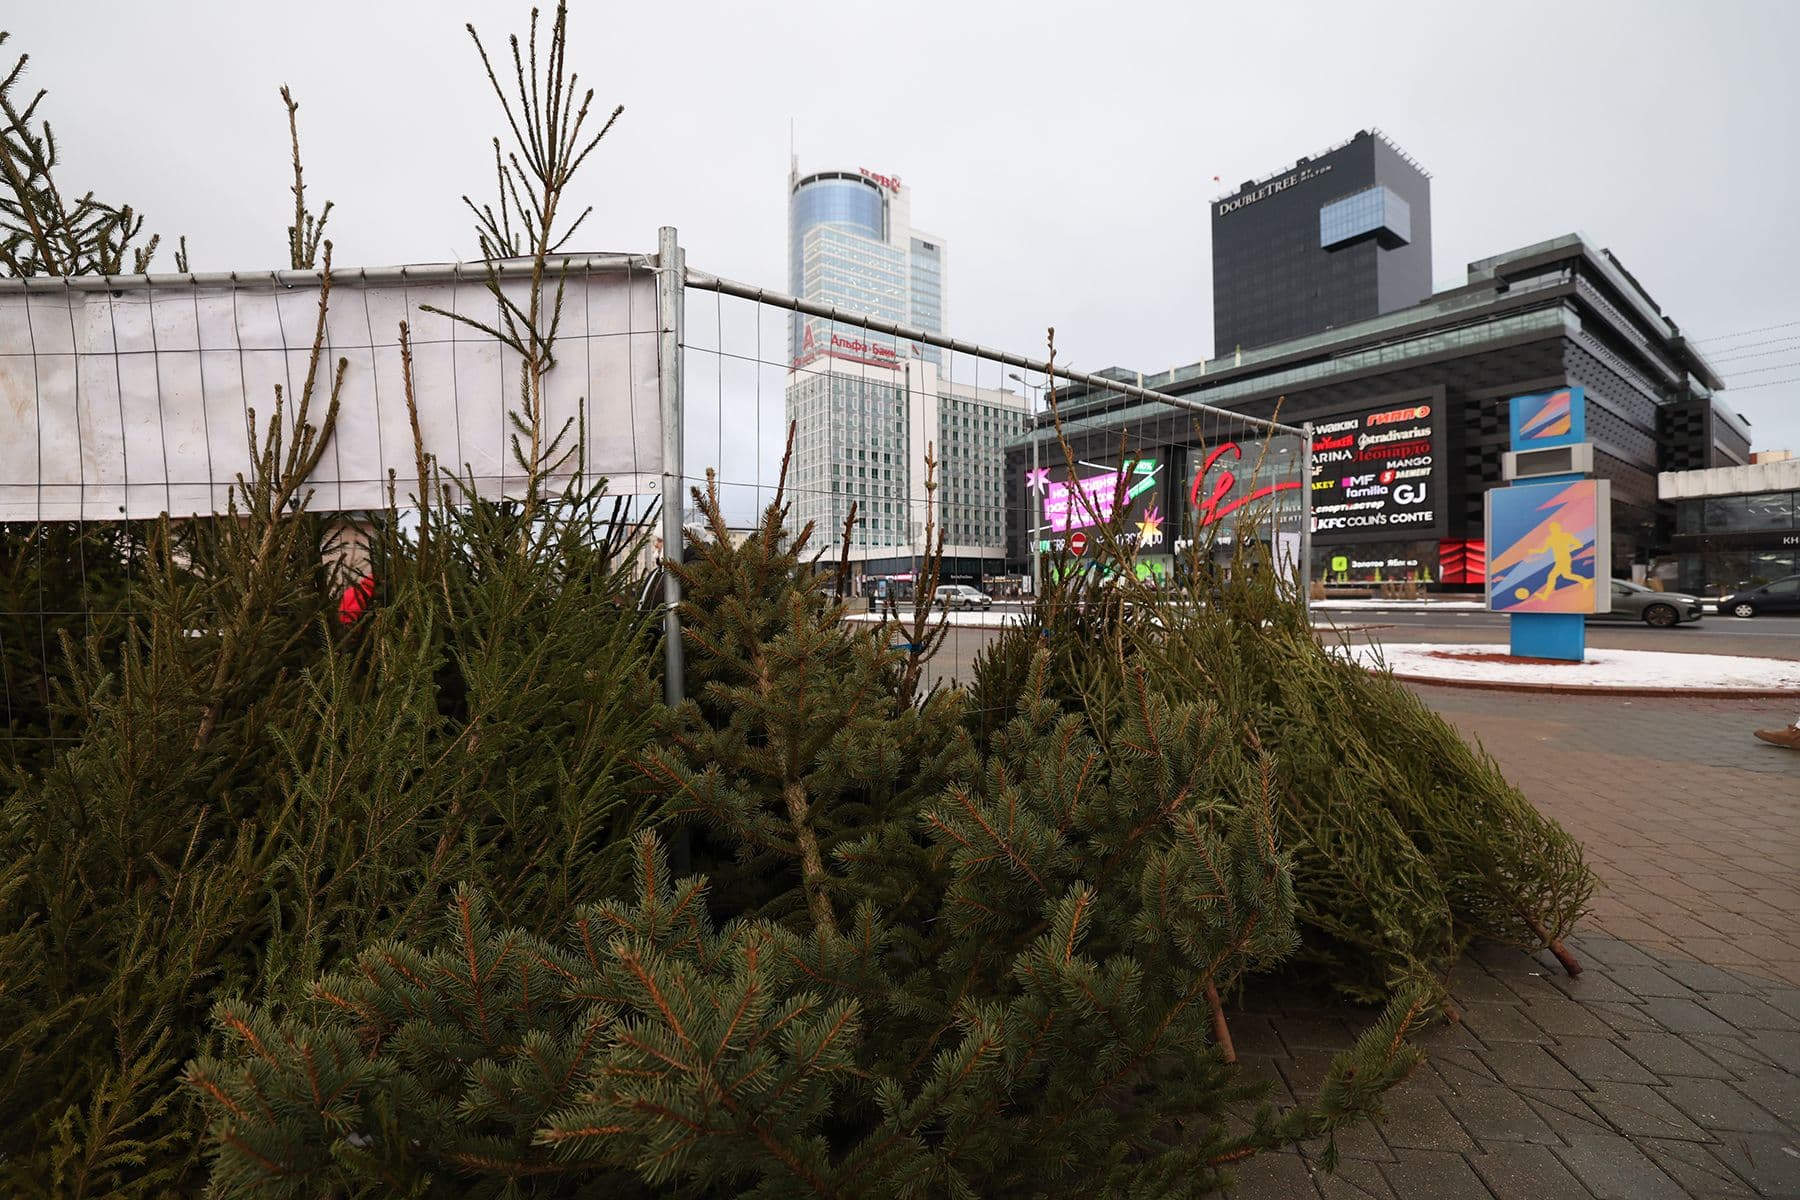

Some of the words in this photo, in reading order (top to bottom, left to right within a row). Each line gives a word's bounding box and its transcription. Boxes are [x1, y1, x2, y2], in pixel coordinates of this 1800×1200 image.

[1219, 174, 1298, 216] DOUBLETREE
[1312, 449, 1352, 464] ARINA
[1386, 456, 1432, 469] MANGO
[1346, 485, 1388, 498] familia
[1318, 517, 1346, 530] KFC
[1389, 511, 1433, 523] CONTE
